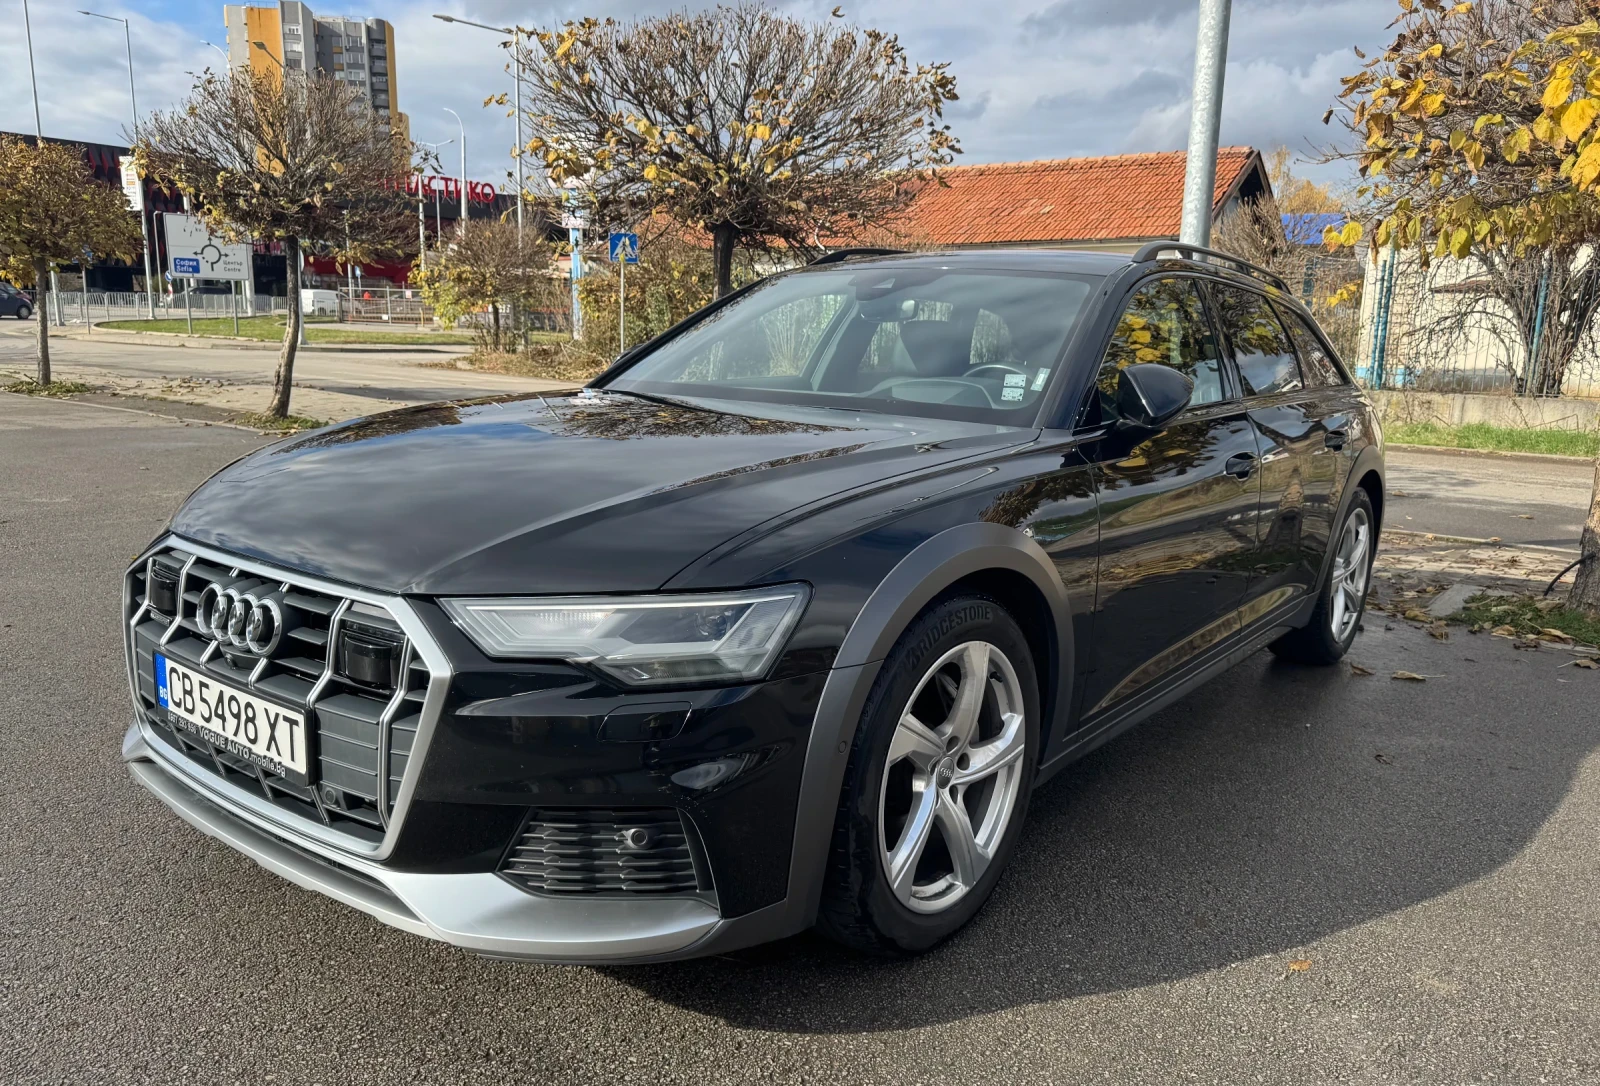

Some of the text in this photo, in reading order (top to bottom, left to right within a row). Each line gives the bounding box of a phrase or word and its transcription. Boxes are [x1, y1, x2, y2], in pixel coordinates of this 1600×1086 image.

[904, 605, 990, 671] BRIDGESTONE
[159, 685, 168, 700] BG
[199, 680, 258, 745] 5498
[200, 726, 226, 748] VOGUE
